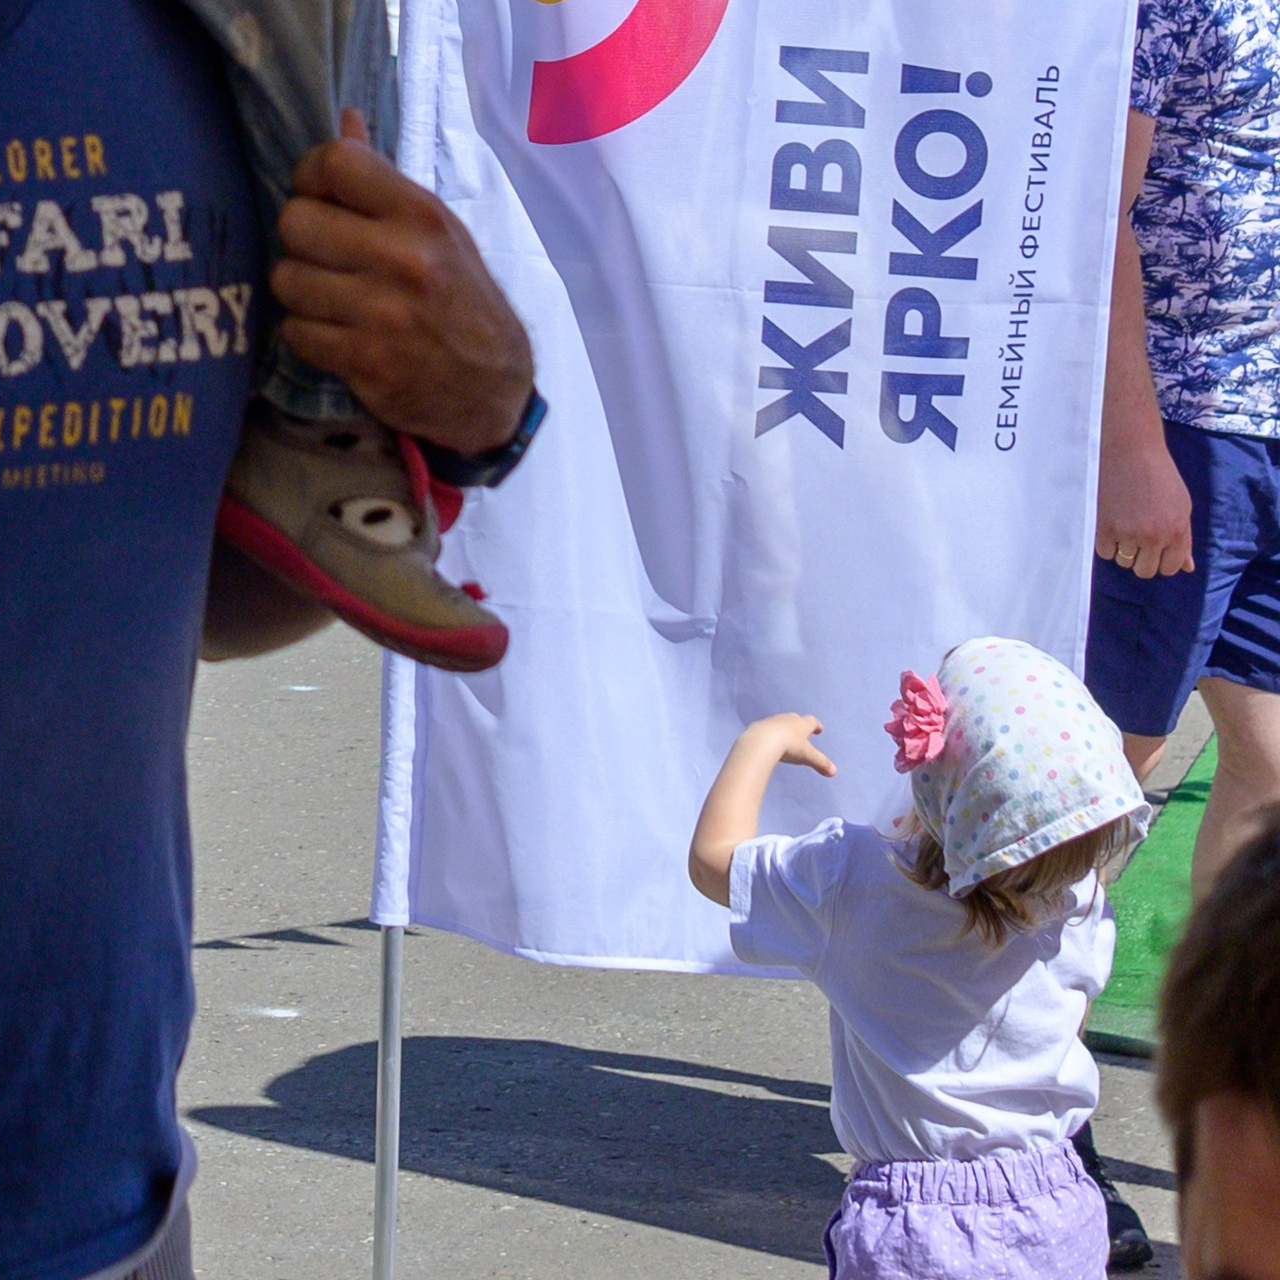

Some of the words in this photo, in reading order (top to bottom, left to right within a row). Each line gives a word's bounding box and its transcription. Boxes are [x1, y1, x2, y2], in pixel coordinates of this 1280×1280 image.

[754, 45, 870, 450] ЖИВИ
[879, 63, 993, 452] ЯРКО!
[994, 270, 1036, 452] СЕМЕЙНЫЙ
[1019, 65, 1060, 260] ФЕСТИВАЛЬ
